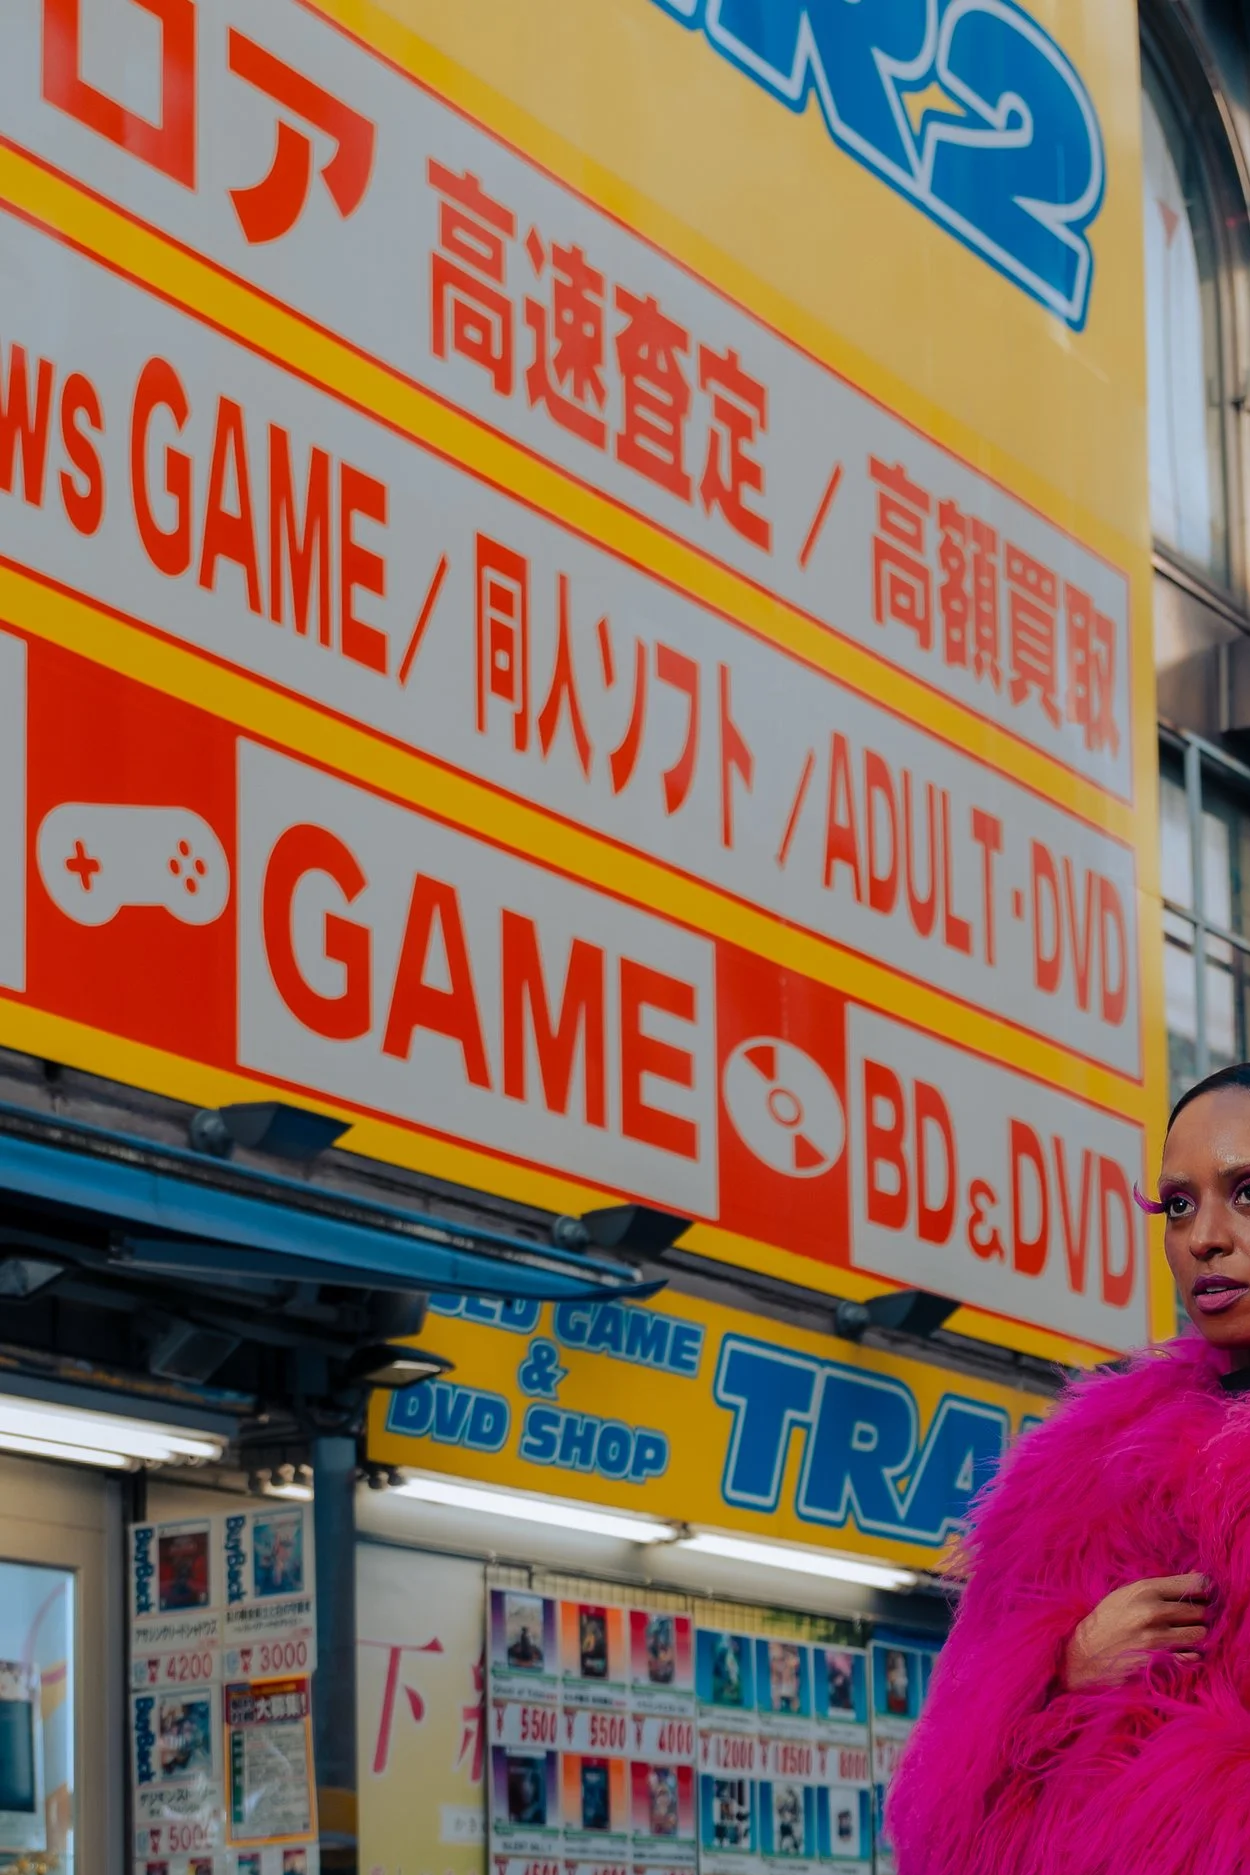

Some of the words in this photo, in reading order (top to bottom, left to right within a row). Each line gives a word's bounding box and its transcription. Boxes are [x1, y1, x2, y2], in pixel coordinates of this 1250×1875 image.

[640, 0, 1108, 332] R2
[42, 0, 378, 246] ロア
[427, 157, 773, 554] 高速査定
[868, 452, 1120, 762] 高額買取
[475, 530, 755, 848] 同人ソフト
[263, 823, 698, 1162] GAME
[517, 1336, 570, 1401] &
[554, 1298, 704, 1379] GAME
[385, 1379, 511, 1453] DVD
[519, 1402, 670, 1485] SHOP
[713, 1331, 1046, 1548] TRA
[521, 1707, 558, 1744] 5500
[590, 1712, 626, 1749] 5500
